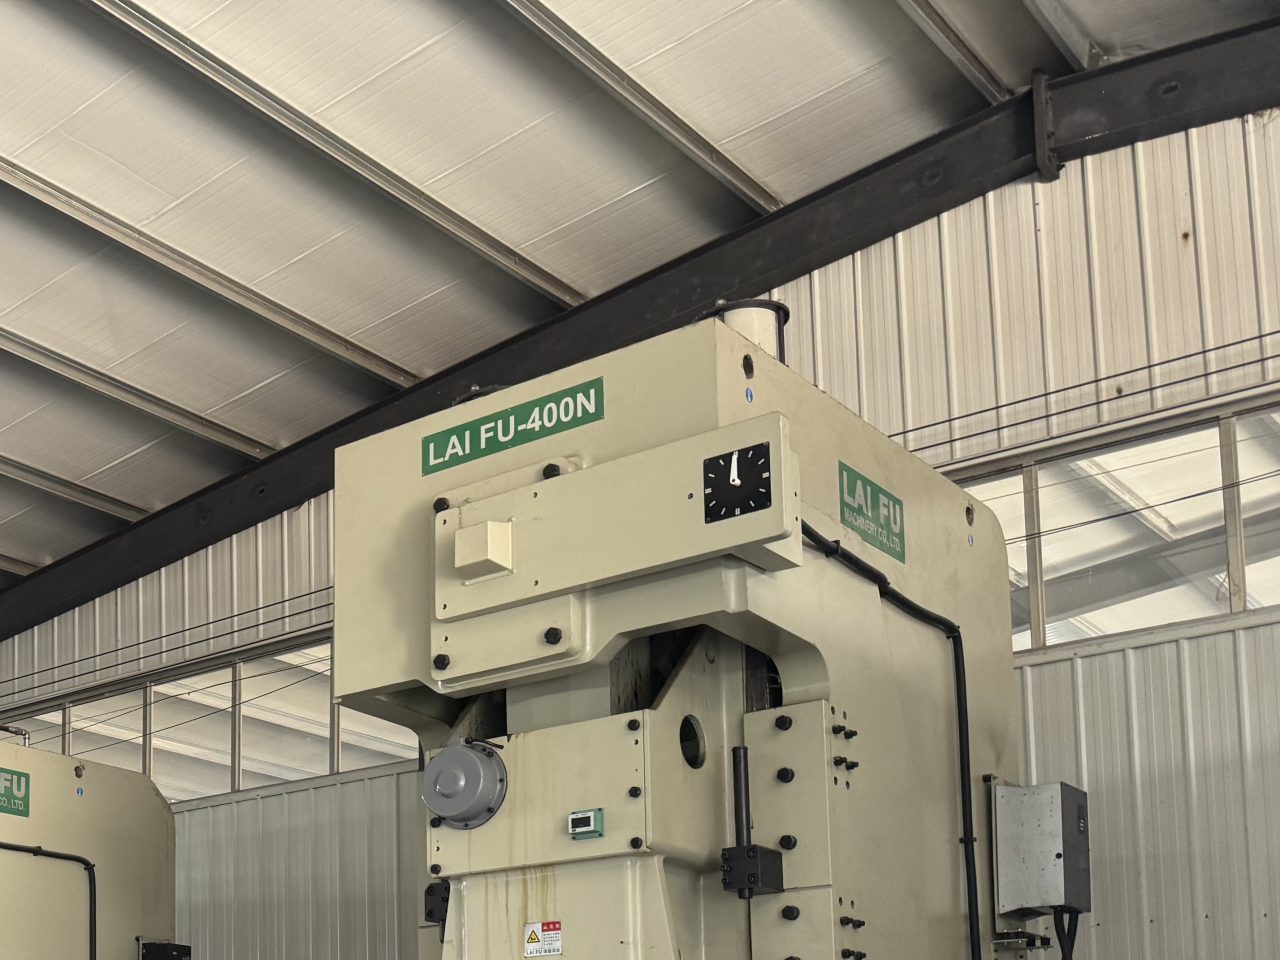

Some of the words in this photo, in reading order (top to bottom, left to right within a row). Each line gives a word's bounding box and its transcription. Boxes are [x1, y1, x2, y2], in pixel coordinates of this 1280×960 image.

[428, 429, 471, 467] LAI
[479, 388, 597, 450] FU-400N
[842, 470, 873, 518] LAI
[879, 494, 901, 534] FU
[844, 506, 878, 537] MACHINERY
[890, 535, 901, 552] LTD.
[0, 773, 26, 798] FU
[11, 798, 26, 811] LTD.
